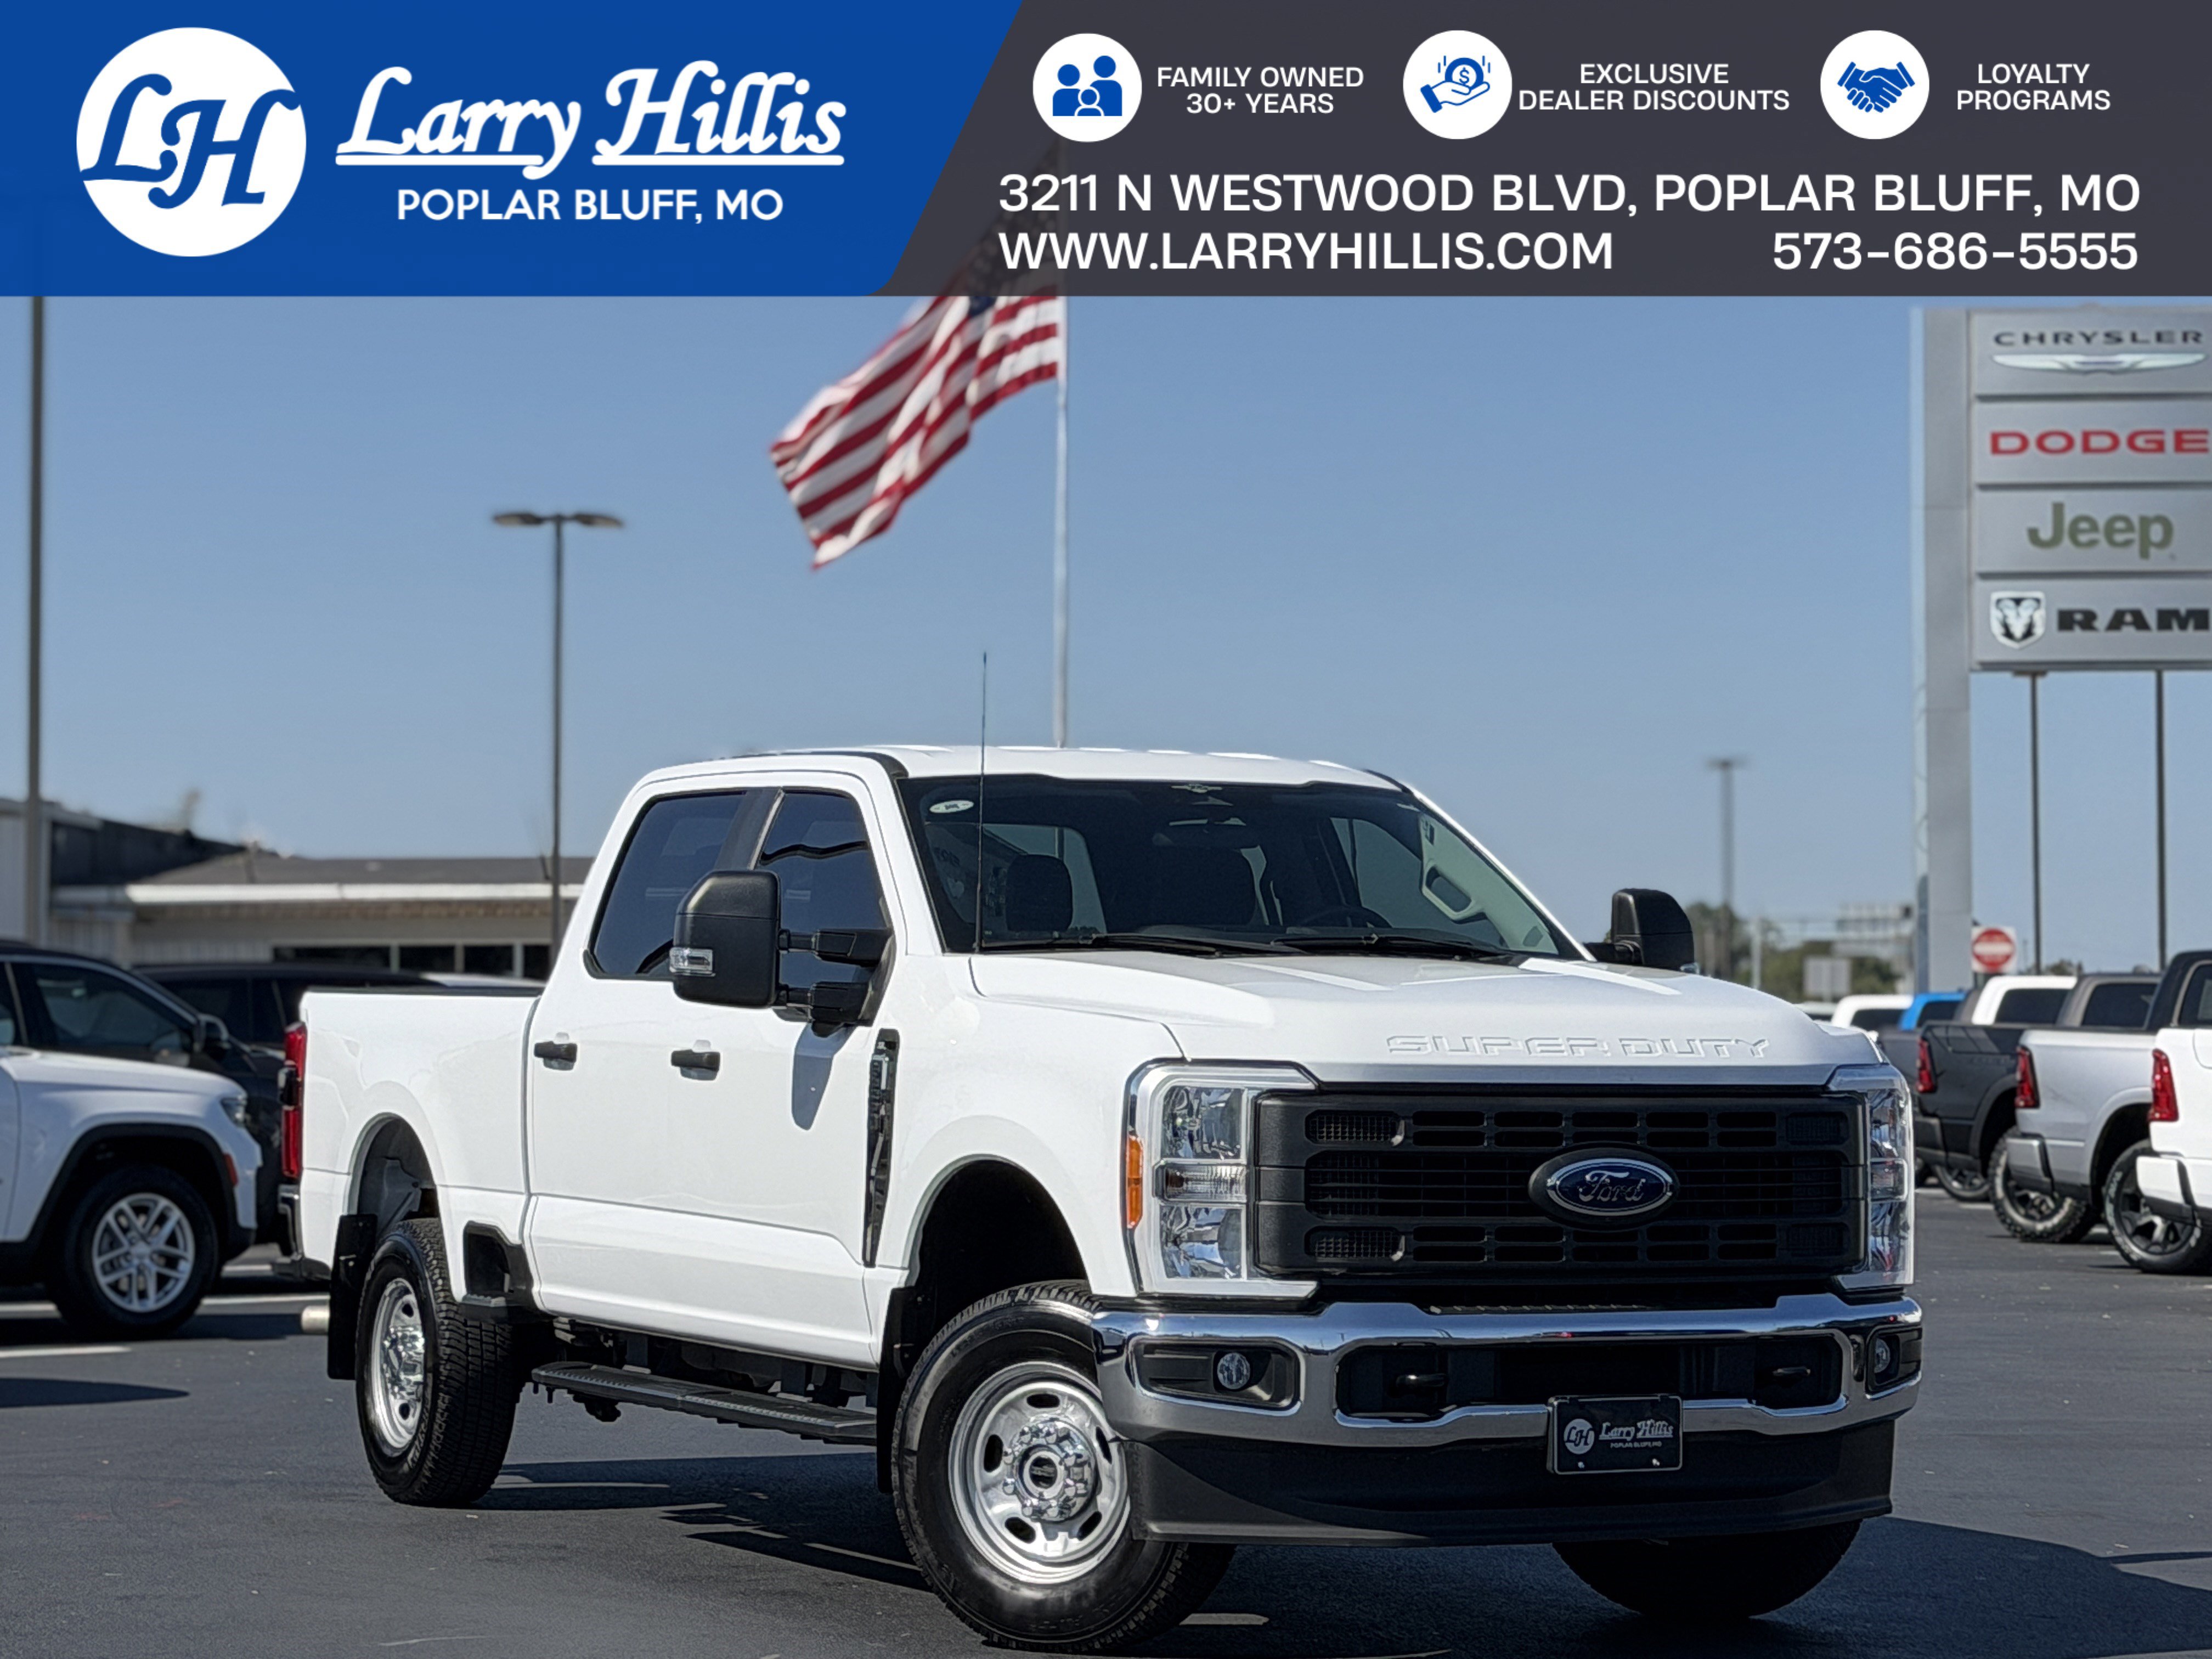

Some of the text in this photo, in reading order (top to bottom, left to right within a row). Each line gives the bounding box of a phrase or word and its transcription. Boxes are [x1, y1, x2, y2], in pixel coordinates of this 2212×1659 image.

[1994, 330, 2203, 347] CHRYSLER
[1990, 430, 2210, 455] DODGE
[2027, 502, 2174, 560] Jeep
[2057, 608, 2210, 631] RAM
[1386, 1035, 1770, 1058] SUPER DUTY
[1577, 1170, 1646, 1203] Ford
[1599, 1419, 1673, 1441] Larry Hillis
